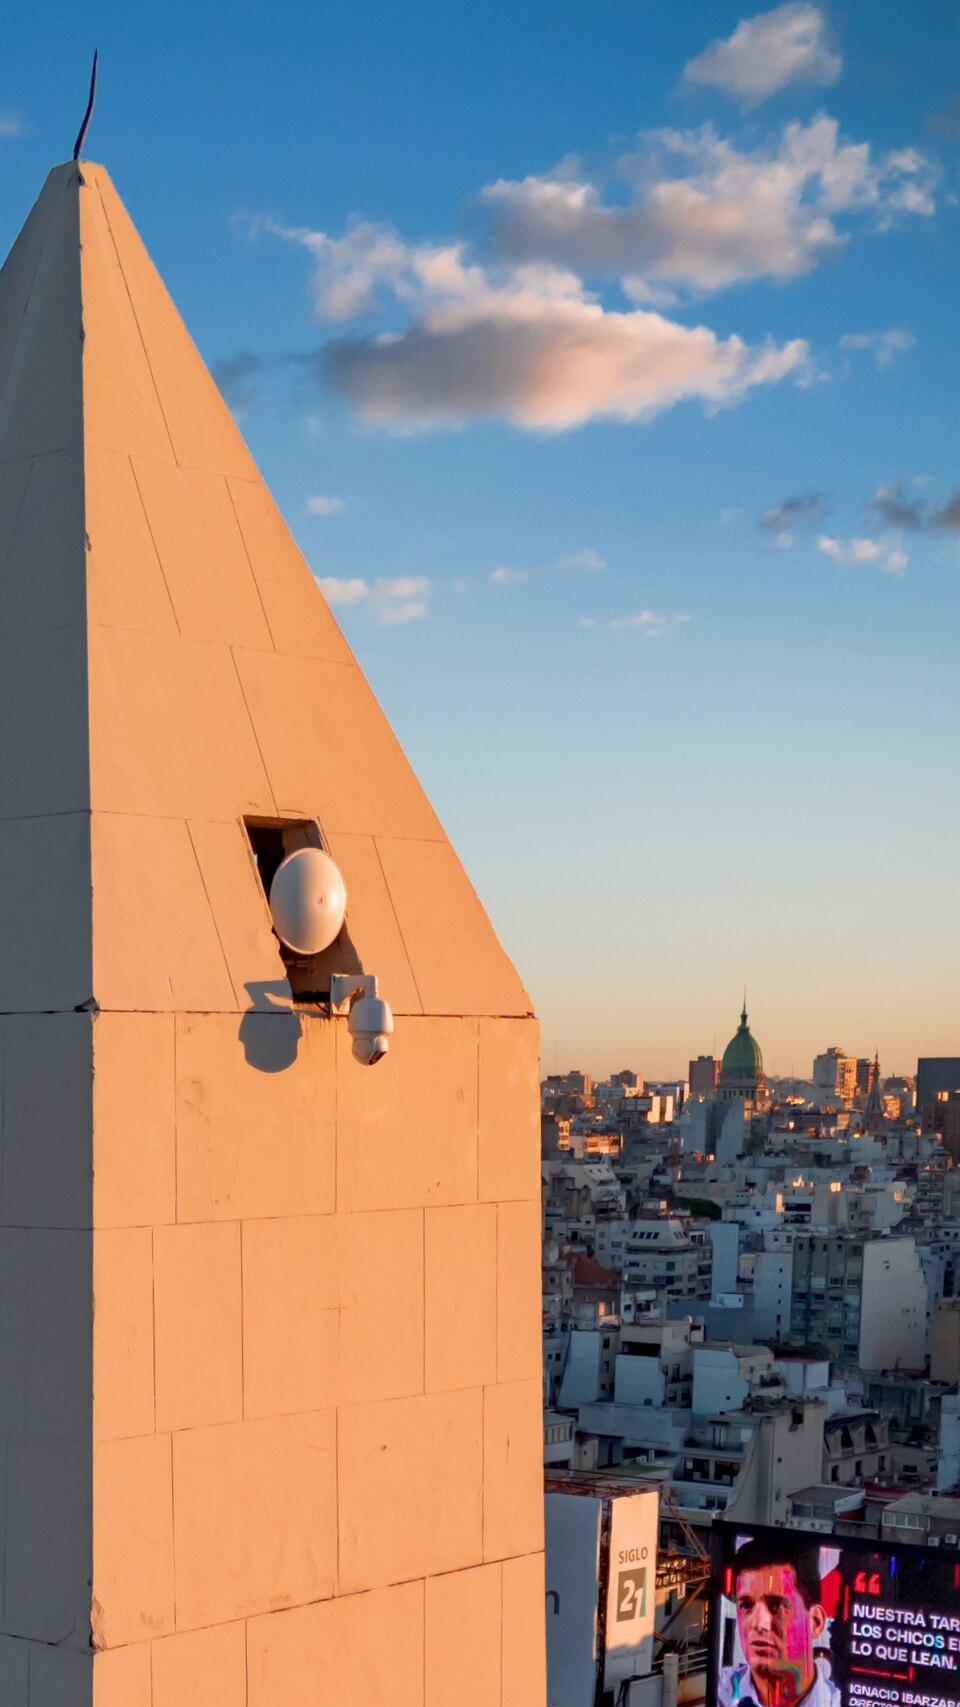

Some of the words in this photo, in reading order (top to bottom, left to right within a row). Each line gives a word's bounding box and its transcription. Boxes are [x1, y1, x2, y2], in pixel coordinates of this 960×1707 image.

[618, 1547, 649, 1564] SIGLO
[620, 1579, 644, 1619] 21
[853, 1603, 926, 1627] NUESTRA
[852, 1622, 882, 1639] LOS
[886, 1628, 945, 1649] CHICOS
[851, 1641, 872, 1656] LO
[875, 1645, 908, 1662] QUE
[911, 1650, 958, 1671] LEAN.
[849, 1684, 899, 1701] IGNACIO
